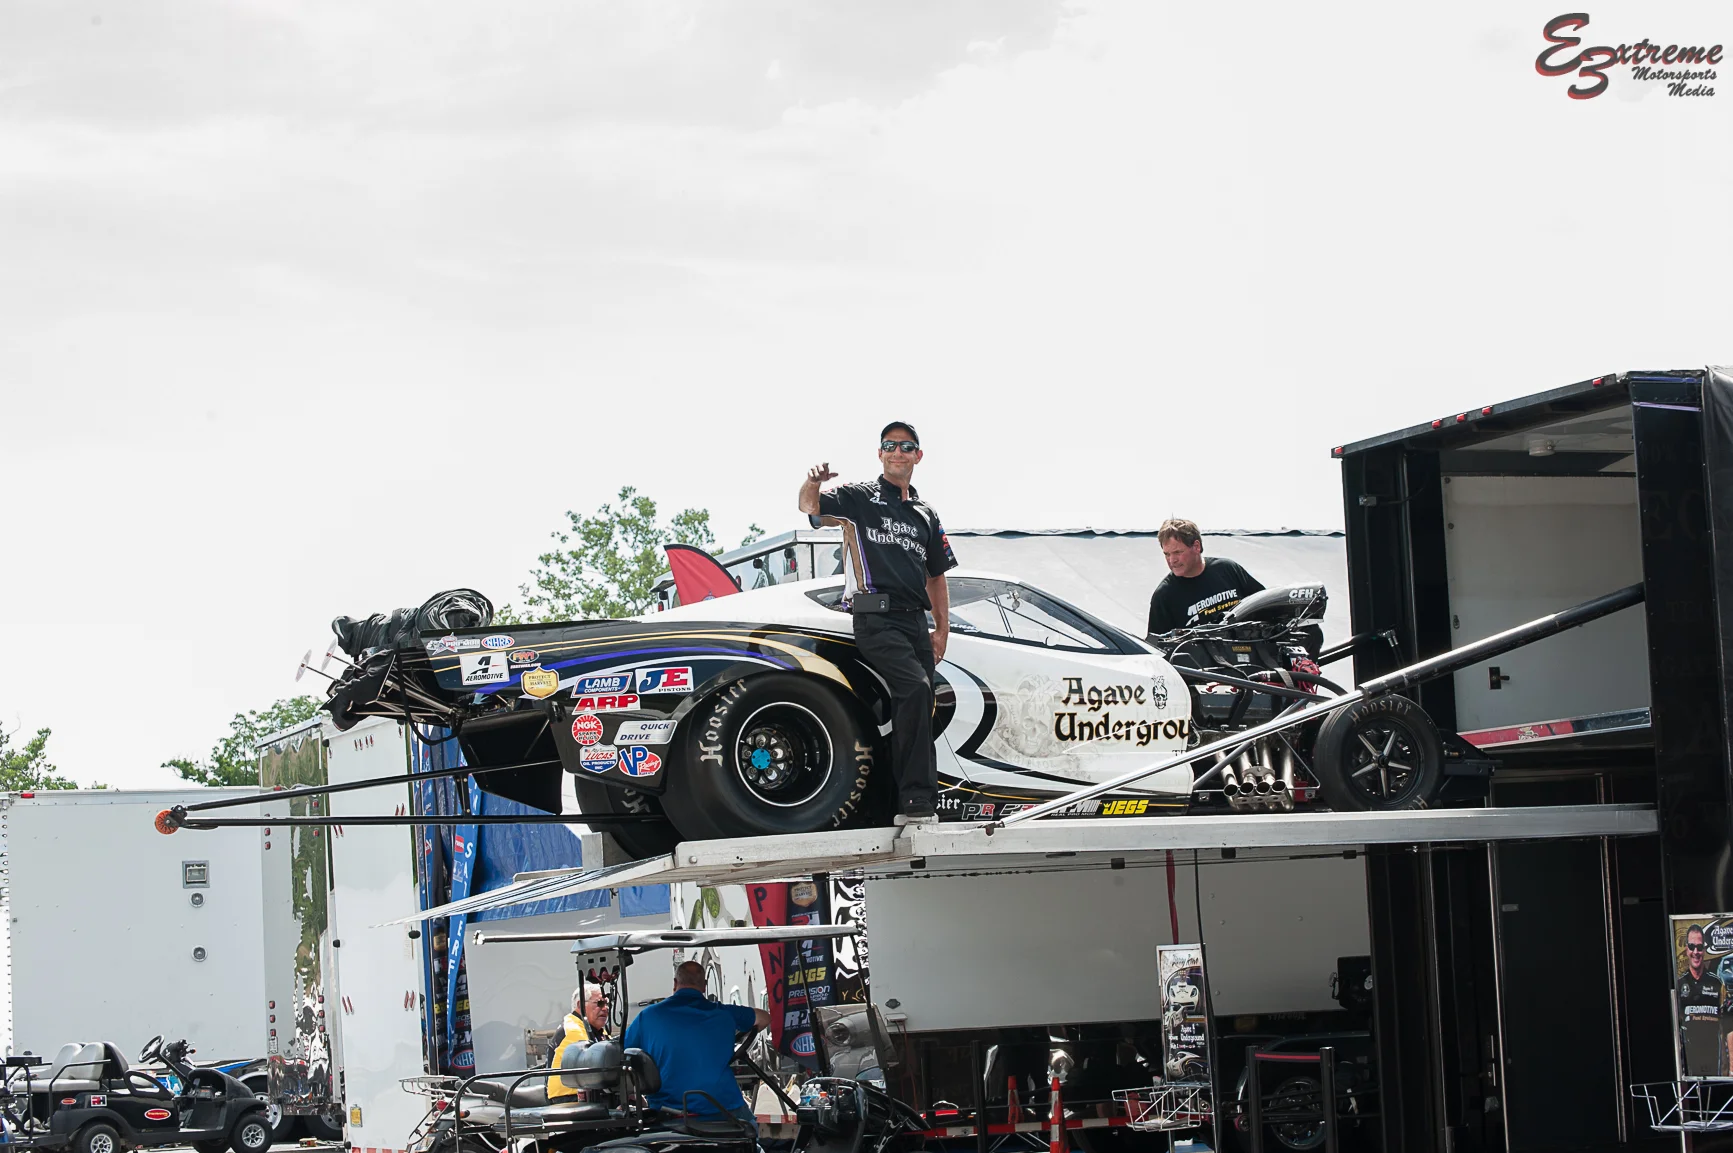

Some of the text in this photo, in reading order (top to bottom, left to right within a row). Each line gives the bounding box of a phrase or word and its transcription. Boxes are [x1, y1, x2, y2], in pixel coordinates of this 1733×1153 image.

[485, 637, 511, 647] NHRA
[465, 672, 504, 682] AEROMOTIVE
[584, 677, 620, 689] LAMB
[638, 668, 689, 693] JE
[584, 686, 617, 694] COMPONENTS
[1062, 677, 1147, 712] Agave
[575, 694, 639, 712] ARP
[576, 720, 598, 730] NGK
[699, 678, 748, 767] Hoosier
[620, 733, 651, 741] DRIVE
[585, 752, 615, 760] LUCAS
[620, 746, 648, 776] VP
[1102, 800, 1150, 815] JEGS
